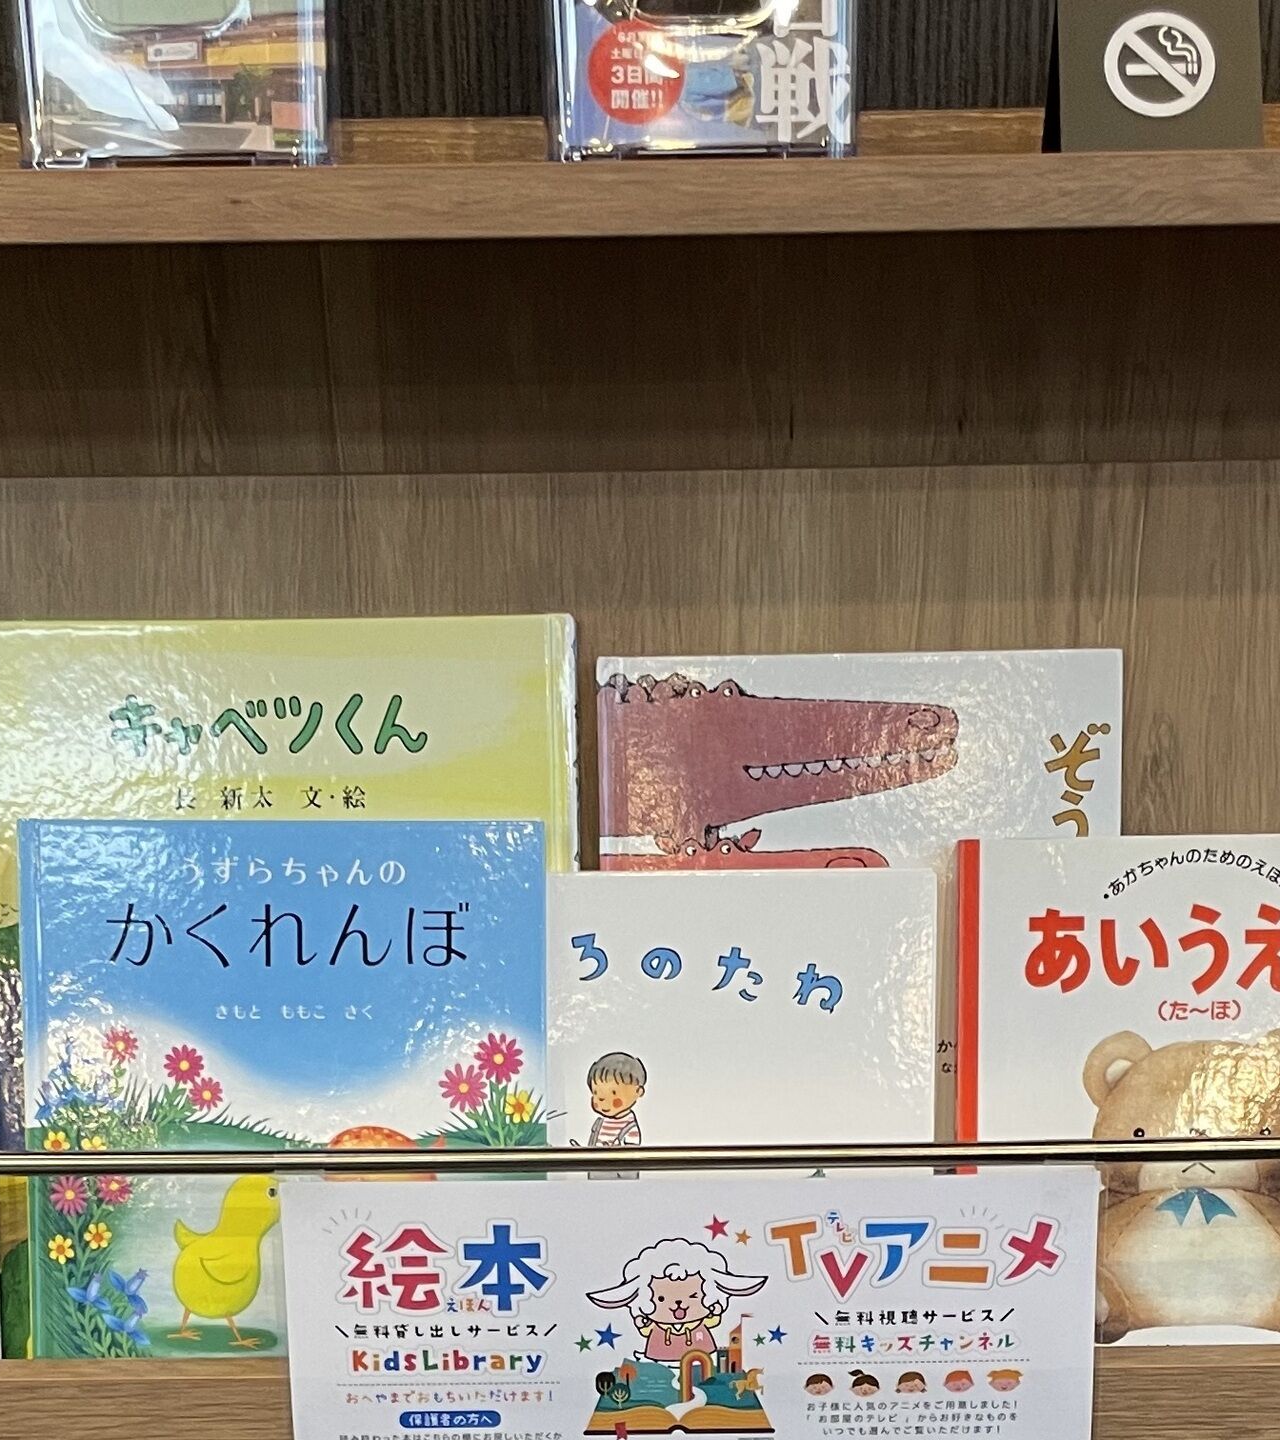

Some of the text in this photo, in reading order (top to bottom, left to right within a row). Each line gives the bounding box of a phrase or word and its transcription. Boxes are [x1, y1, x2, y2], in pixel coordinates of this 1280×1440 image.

[755, 36, 851, 144] 戦
[110, 694, 429, 755] キャベツくん
[220, 785, 274, 810] 新太
[300, 784, 366, 810] 文・絵
[181, 857, 407, 888] うずらちゃんの
[106, 902, 471, 968] かくれんぼ
[826, 1211, 854, 1243] テレビ
[344, 1223, 549, 1312] 絵本
[770, 1220, 1059, 1298] TVアニメ
[446, 1298, 490, 1313] えほん
[812, 1332, 1015, 1354] 無料キッズチャンネル
[408, 1412, 493, 1427] 保護者の方へ
